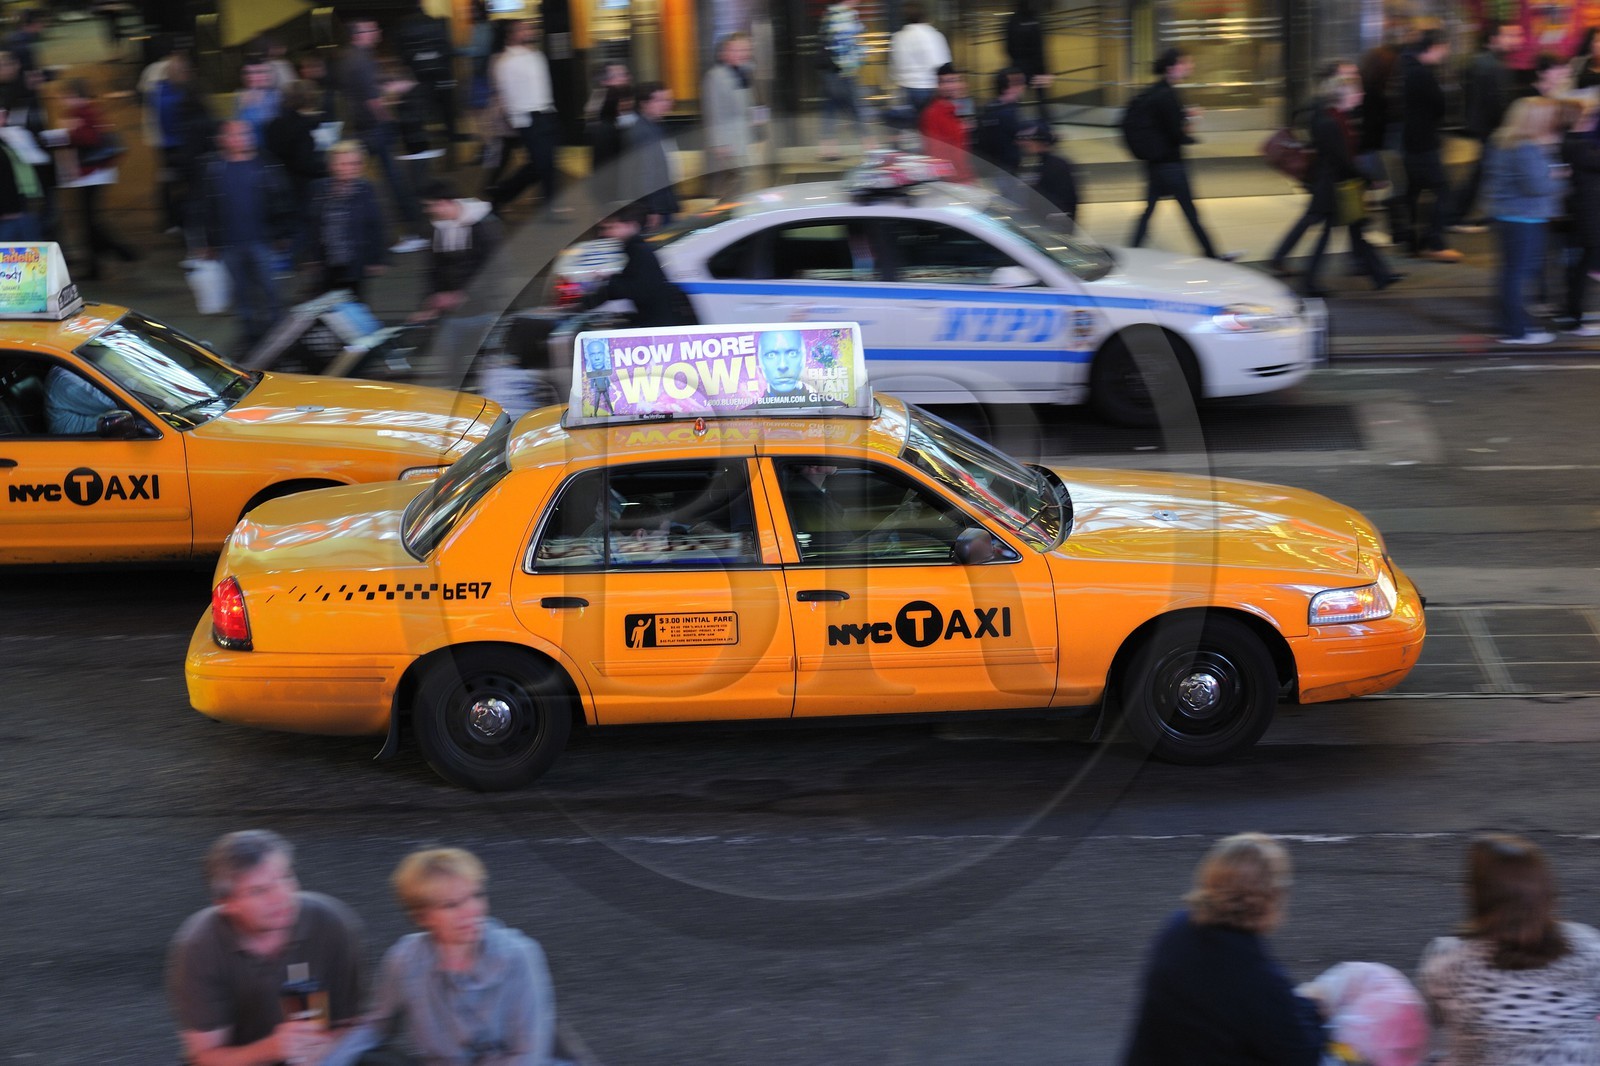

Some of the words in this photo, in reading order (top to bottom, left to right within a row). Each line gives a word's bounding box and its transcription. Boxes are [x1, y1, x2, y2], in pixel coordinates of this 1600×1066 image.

[613, 343, 675, 368] NOW
[680, 335, 756, 360] MORE
[614, 354, 759, 405] WOW!
[808, 367, 848, 381] BLUE
[808, 392, 850, 403] GROUP
[8, 484, 62, 503] NYC
[70, 473, 160, 503] TAXI
[659, 617, 680, 625] $3.00
[828, 622, 893, 646] NYC
[904, 606, 1011, 643] TAXI
